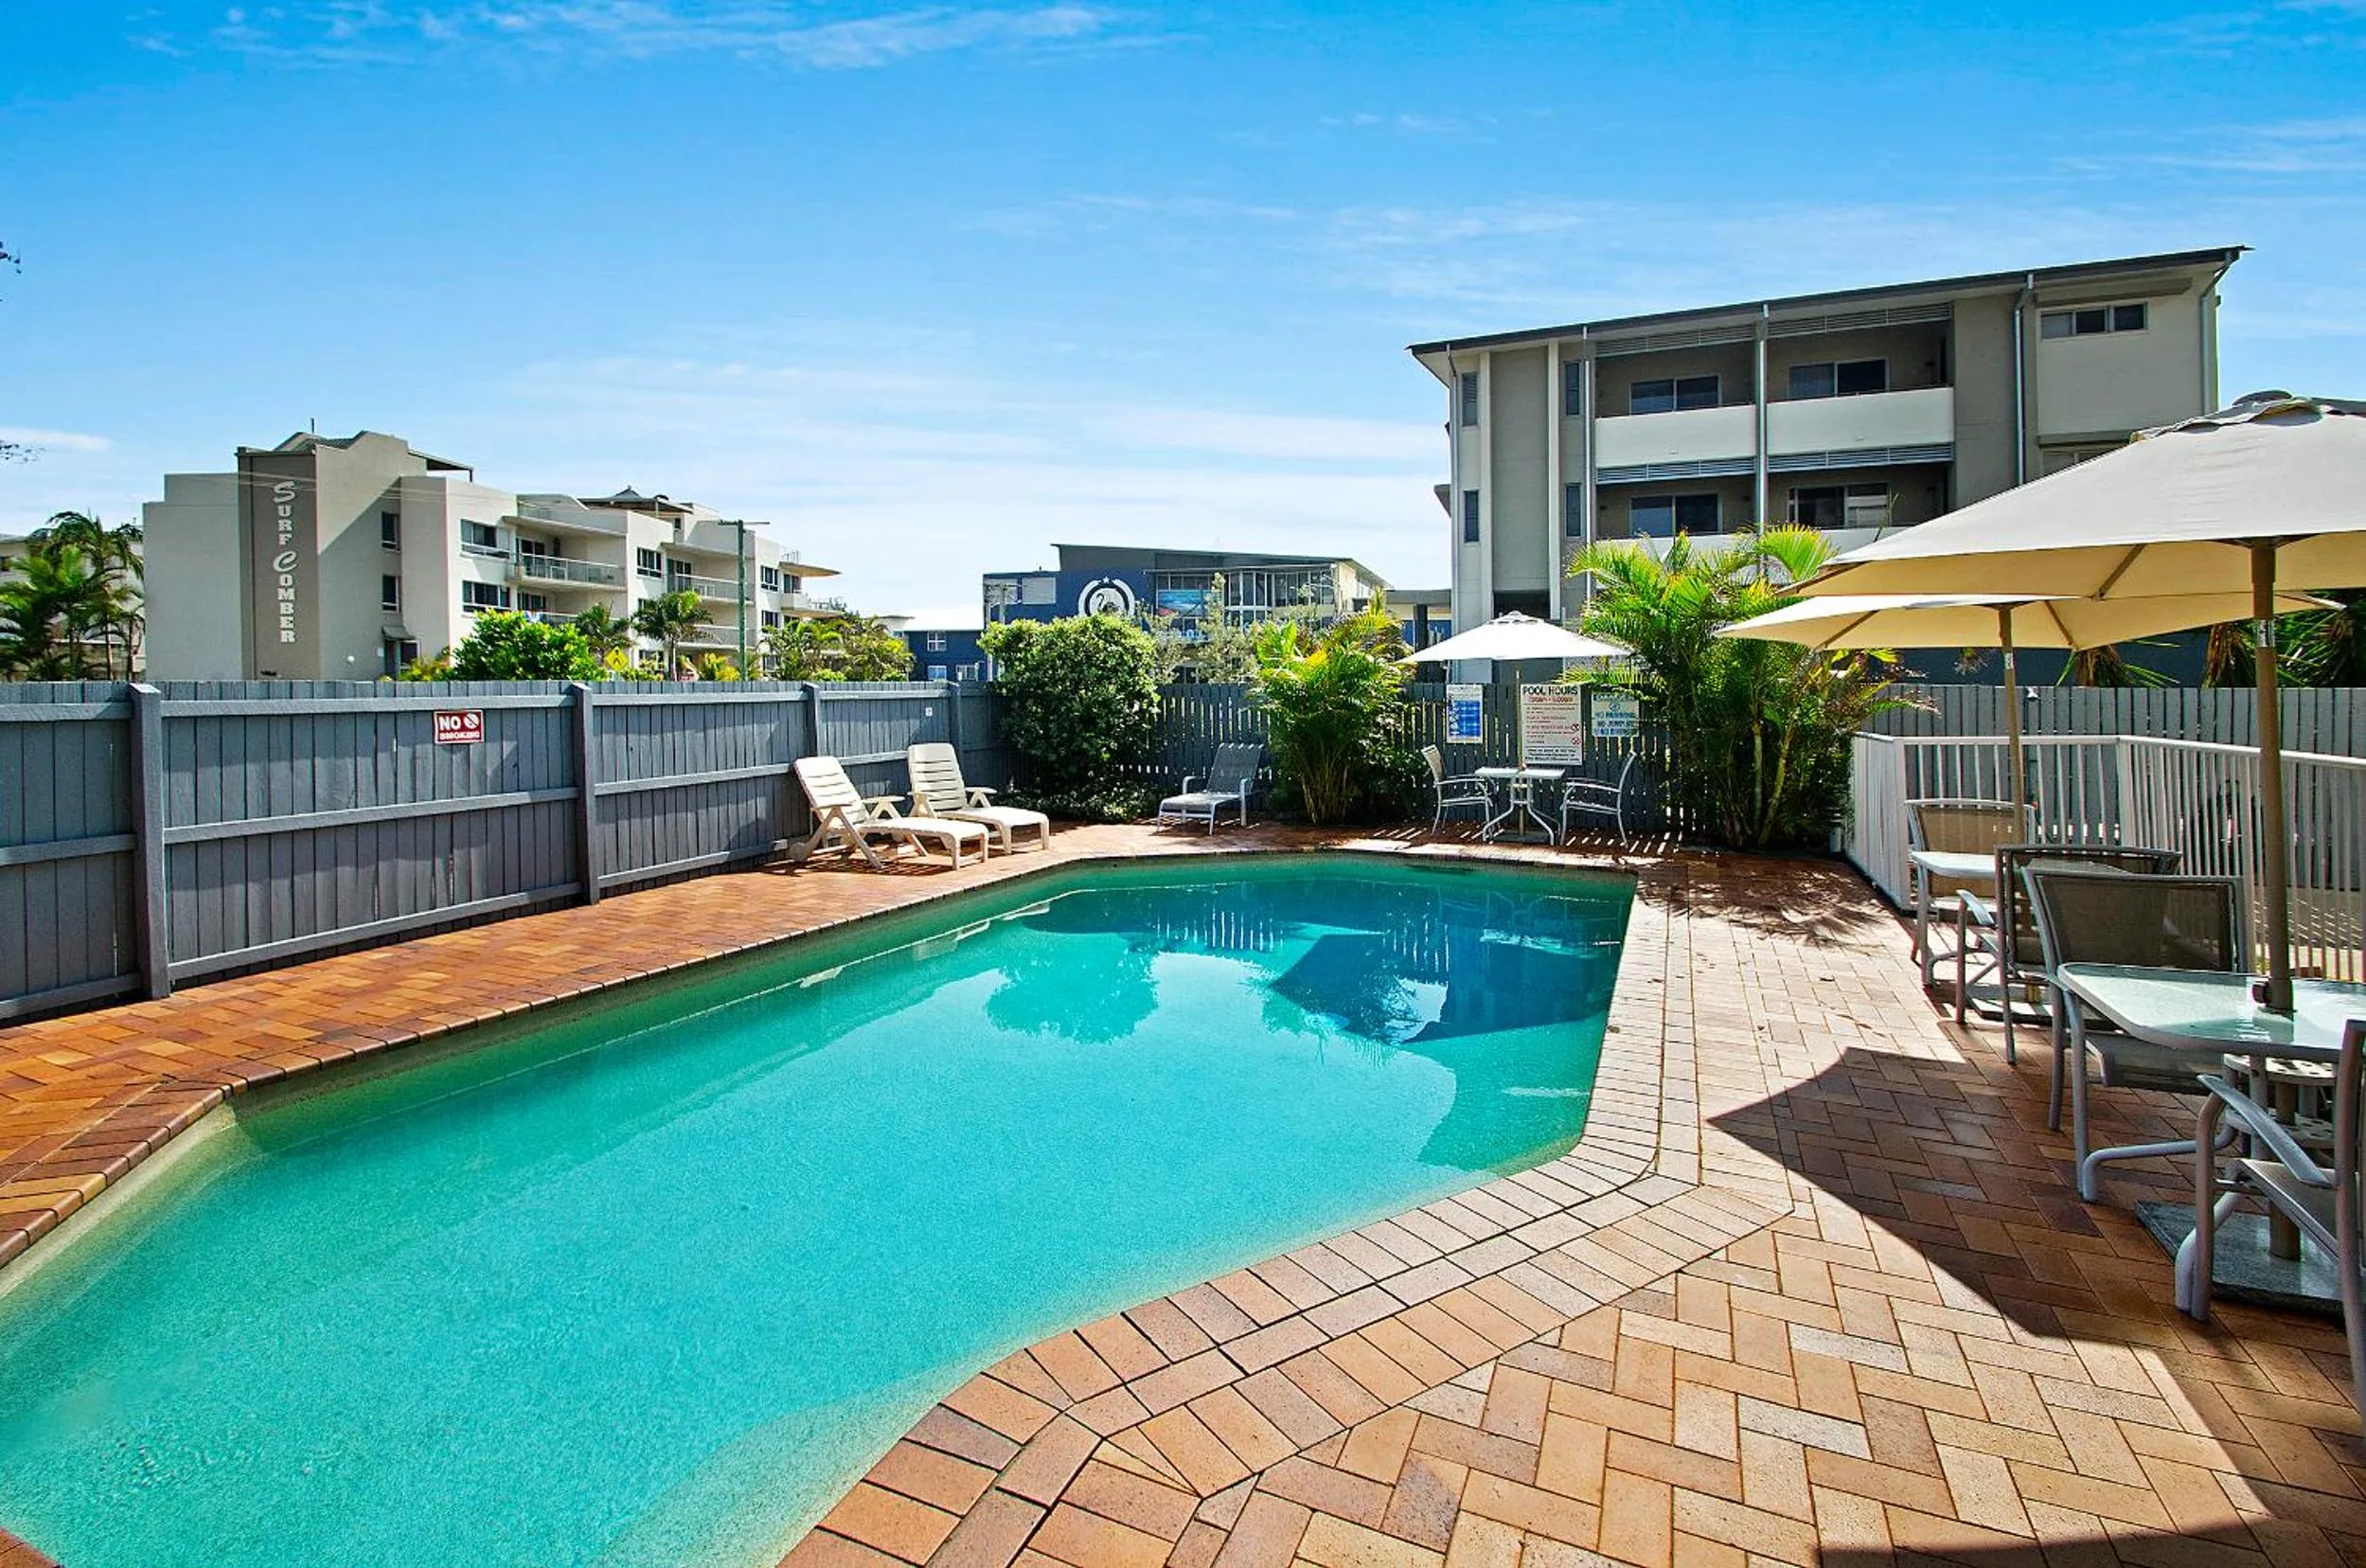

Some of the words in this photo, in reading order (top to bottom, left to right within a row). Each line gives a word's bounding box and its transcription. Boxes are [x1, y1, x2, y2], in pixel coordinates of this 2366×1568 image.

[273, 480, 296, 546] SURF
[273, 549, 297, 644] COMBER
[1522, 686, 1546, 696] POOL
[1549, 685, 1578, 696] HOURS
[438, 716, 461, 731] NO
[439, 730, 480, 740] SMOKING
